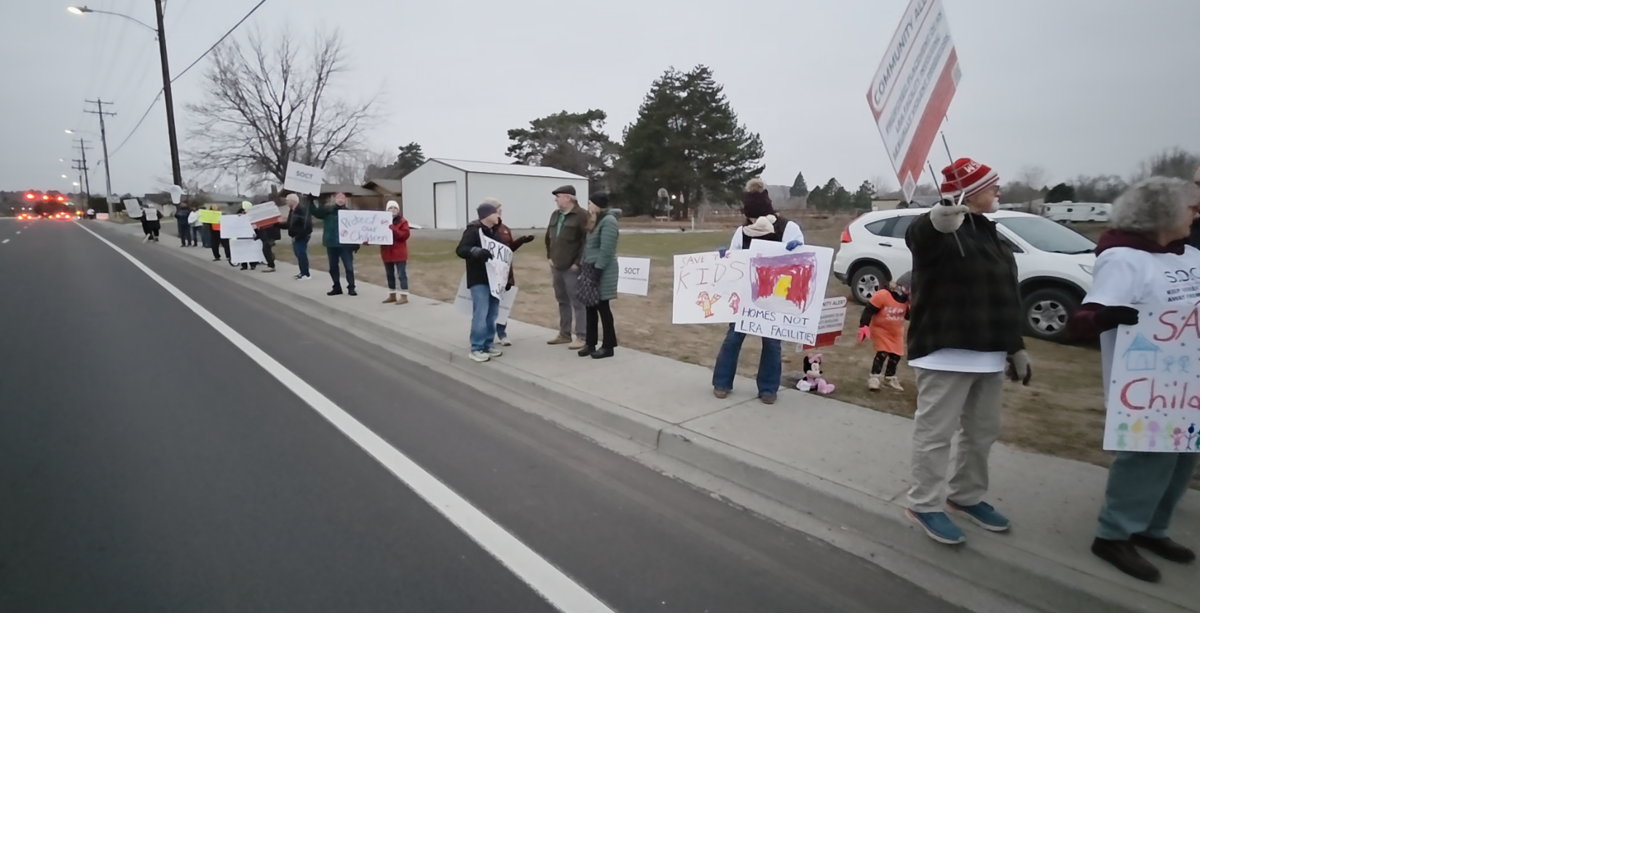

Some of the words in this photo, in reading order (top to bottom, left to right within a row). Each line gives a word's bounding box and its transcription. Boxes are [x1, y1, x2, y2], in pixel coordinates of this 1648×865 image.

[873, 16, 914, 106] COMMUNITY
[296, 170, 313, 180] SOCT
[340, 213, 377, 228] Protect
[349, 230, 389, 243] Children
[680, 256, 705, 269] SAVE
[714, 252, 731, 260] TE
[624, 267, 640, 275] SOCT
[677, 261, 747, 294] KIDS
[742, 307, 776, 322] HOMES
[783, 315, 810, 326] NOT
[740, 320, 763, 334] LRA
[771, 325, 815, 344] FACILITIES
